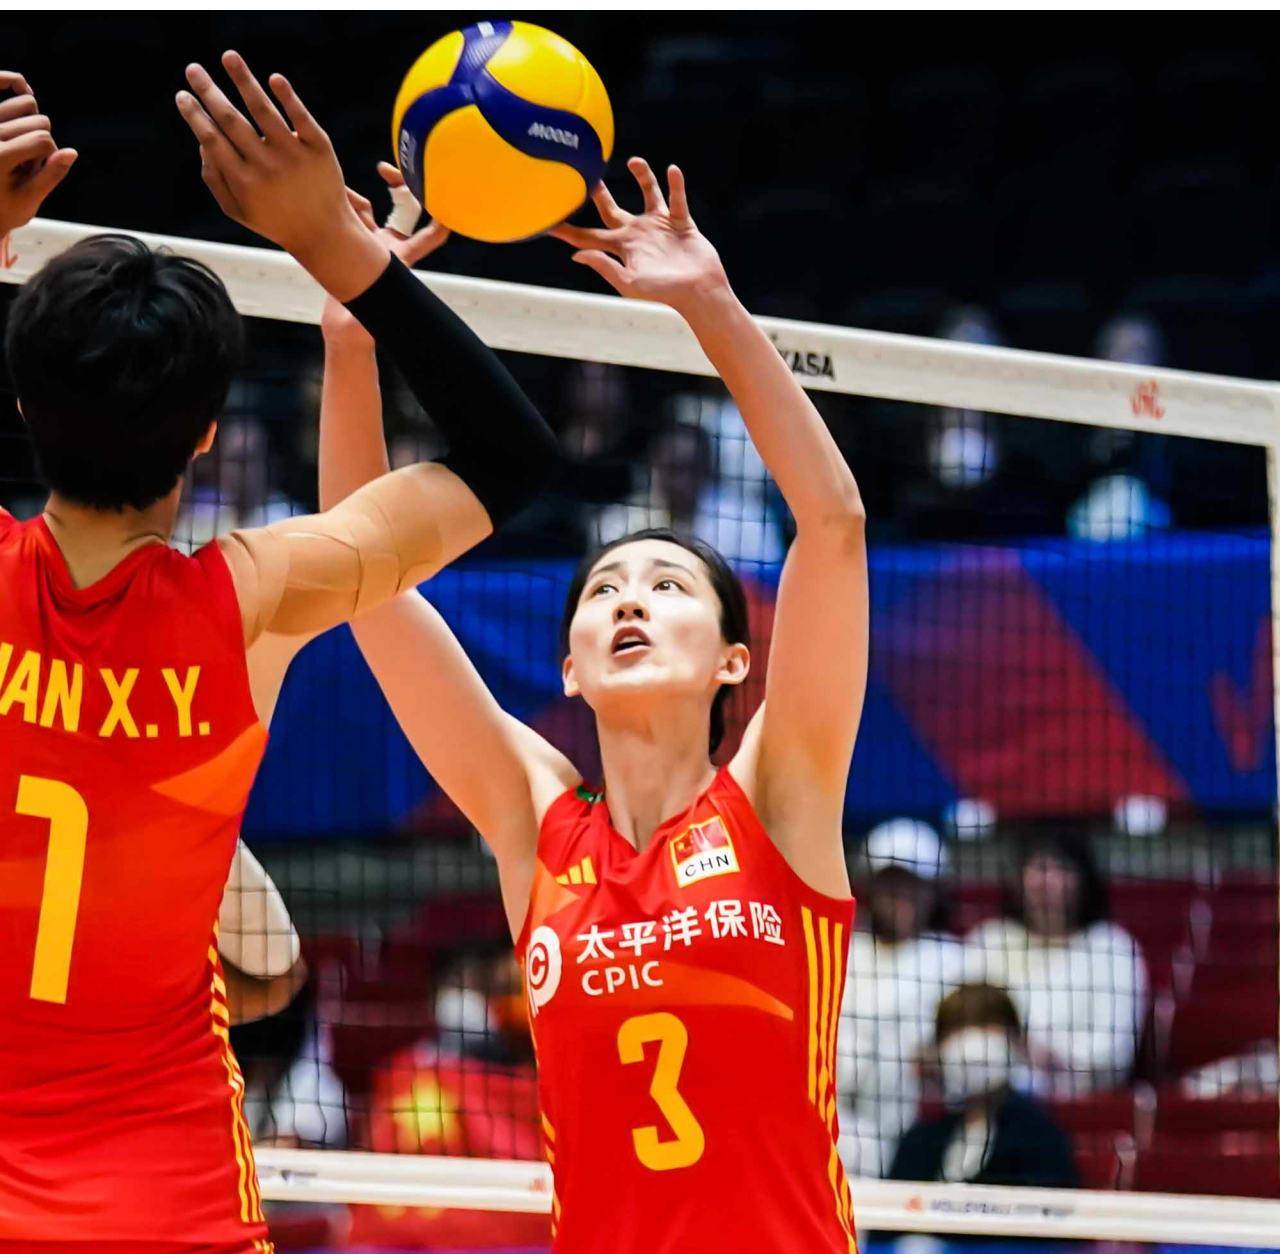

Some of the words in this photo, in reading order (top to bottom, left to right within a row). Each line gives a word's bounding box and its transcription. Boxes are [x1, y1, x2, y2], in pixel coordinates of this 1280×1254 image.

[778, 349, 837, 382] ASA
[15, 774, 90, 1005] 1
[685, 854, 730, 878] CHN
[576, 899, 786, 964] 太平洋保险
[581, 960, 664, 997] CPIC
[617, 1011, 706, 1172] 3
